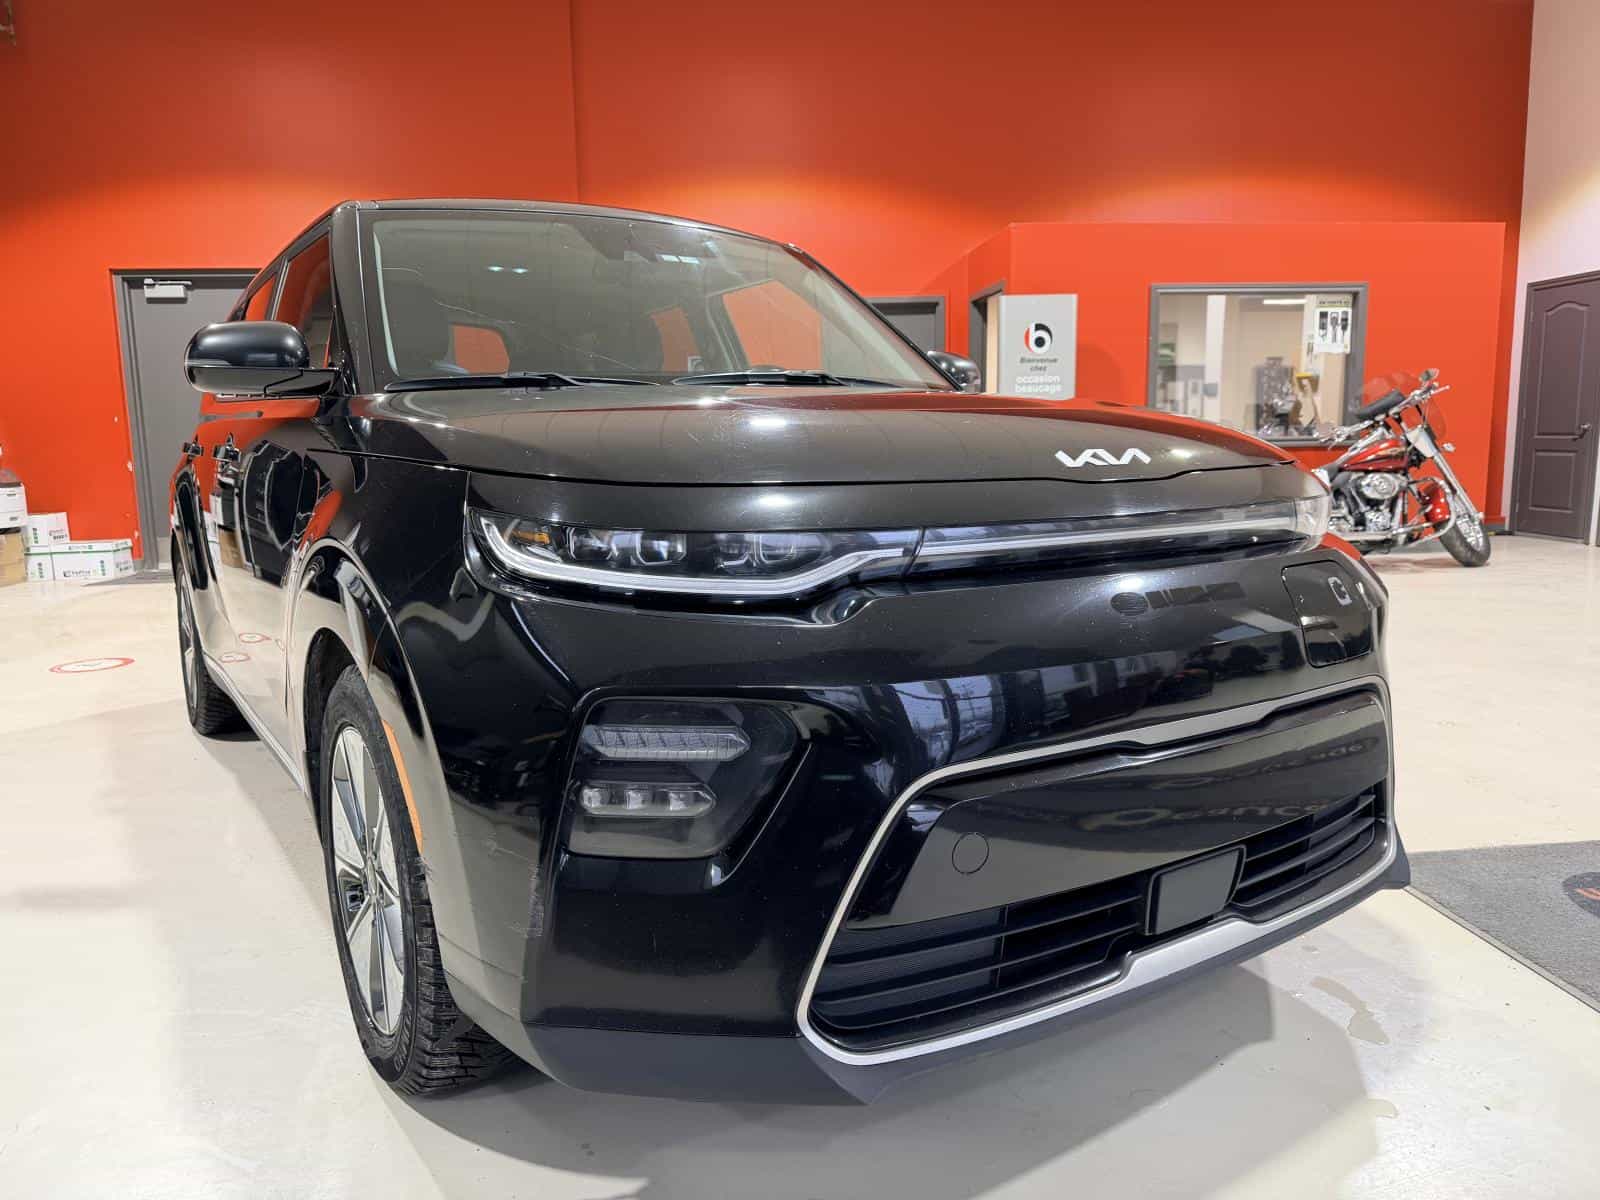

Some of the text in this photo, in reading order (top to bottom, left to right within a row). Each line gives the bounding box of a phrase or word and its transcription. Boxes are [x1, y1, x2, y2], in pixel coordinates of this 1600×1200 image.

[1019, 356, 1059, 365] Bienvenue
[1029, 365, 1048, 373] chez
[1015, 375, 1061, 384] occasion
[1015, 384, 1062, 395] beaucage
[1054, 447, 1152, 468] KIA
